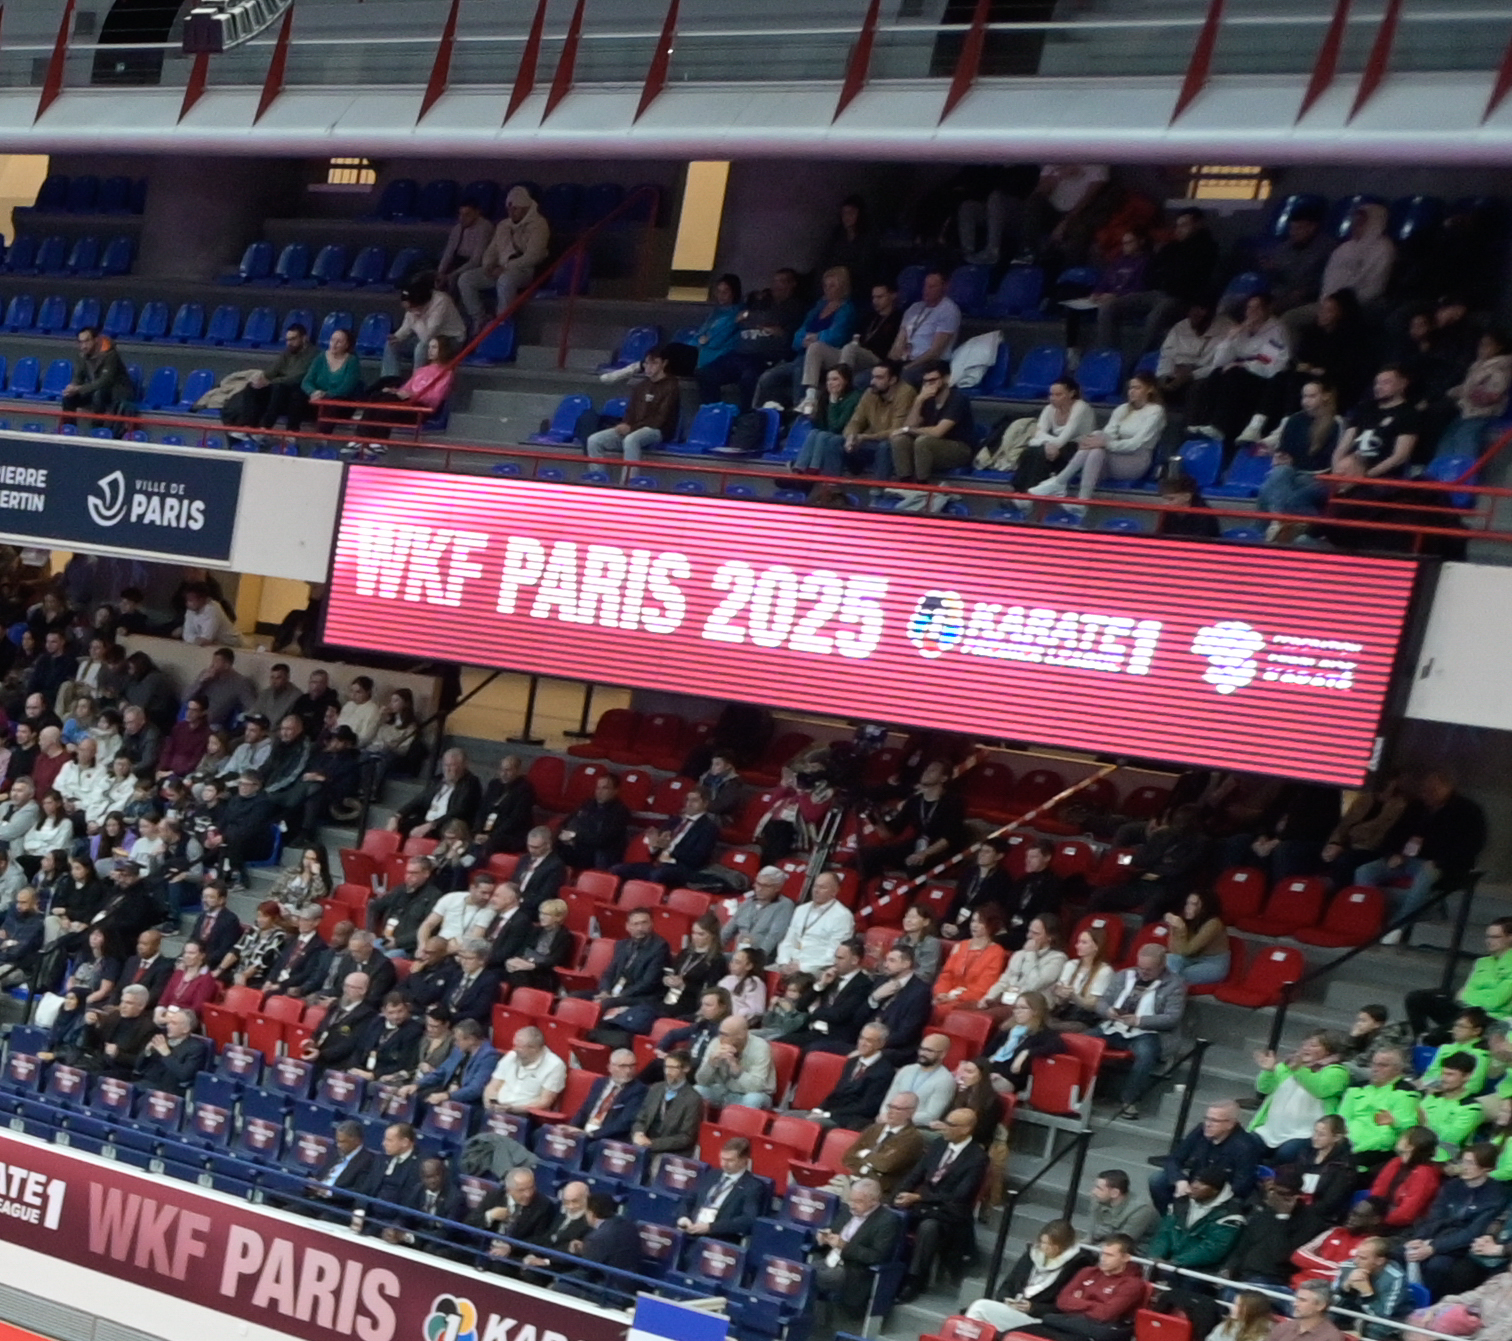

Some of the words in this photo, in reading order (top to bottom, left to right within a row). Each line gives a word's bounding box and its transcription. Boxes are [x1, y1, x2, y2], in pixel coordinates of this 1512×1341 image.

[130, 493, 206, 530] PARIS
[135, 480, 167, 493] VILLE
[170, 483, 186, 495] DE
[356, 524, 489, 607] WKF
[496, 536, 692, 633] PARIS
[702, 560, 889, 659] 2025
[89, 1181, 212, 1282] WKF
